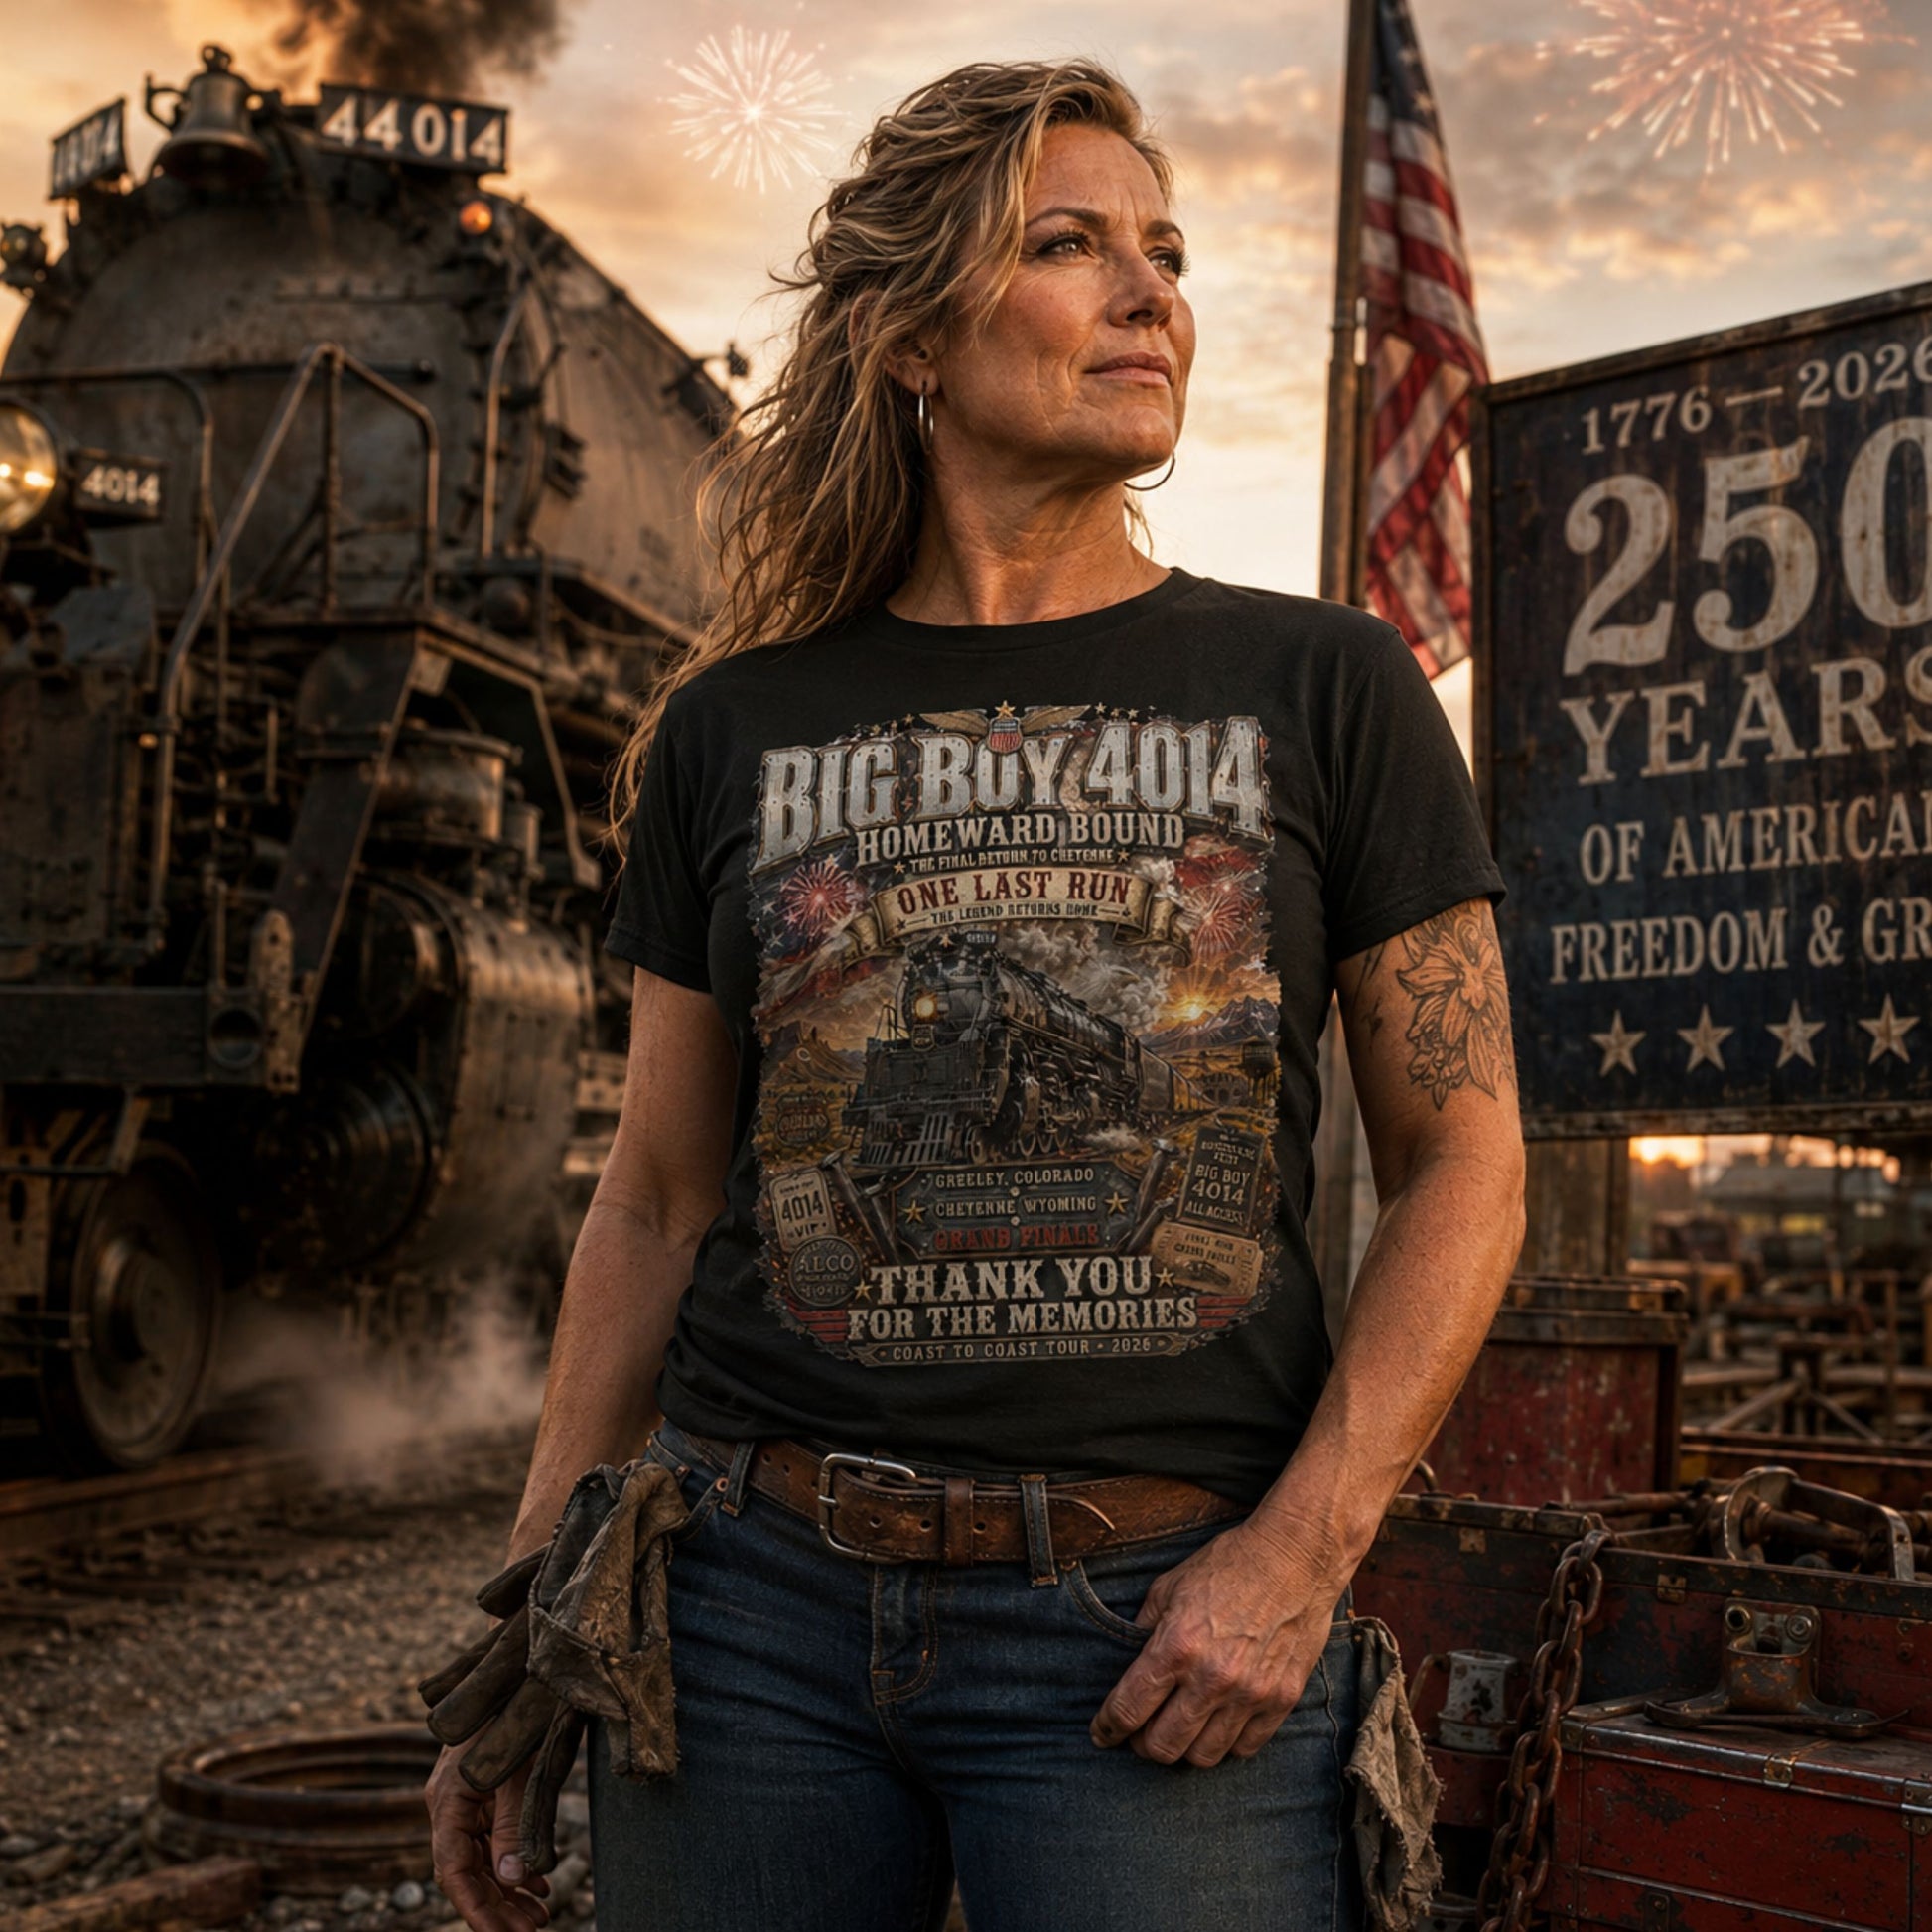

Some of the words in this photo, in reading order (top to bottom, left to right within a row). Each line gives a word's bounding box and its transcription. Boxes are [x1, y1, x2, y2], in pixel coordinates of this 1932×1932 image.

[322, 94, 503, 166] 44014
[1581, 385, 1713, 454] 1776
[1798, 335, 1932, 410] 2026
[81, 465, 160, 506] 4014
[1562, 416, 1932, 677] 250
[752, 741, 901, 872] BIG
[907, 732, 1074, 823] BOY
[1084, 715, 1273, 844] 4014
[855, 812, 1057, 866] HOMEWARD
[1070, 812, 1184, 849] BOUND
[1580, 820, 1644, 885] OF
[897, 877, 959, 914] ONE
[973, 870, 1052, 901] LAST
[1066, 871, 1133, 904] RUN
[1550, 907, 1789, 984] FREEDOM
[1807, 903, 1844, 968] &
[1014, 1167, 1094, 1184] COLORADO
[1191, 1178, 1244, 1206] 4014
[1195, 1164, 1219, 1180] BIG
[1222, 1168, 1251, 1186] BOY
[782, 1191, 824, 1223] 4014
[1023, 1196, 1096, 1213] WYOMING
[794, 1254, 854, 1274] ALCO
[870, 1258, 1045, 1306] THANK
[1055, 1255, 1153, 1298] YOU
[847, 1307, 916, 1340] FOR
[926, 1304, 996, 1337] THE
[1007, 1296, 1197, 1335] MEMORIES
[893, 1345, 945, 1361] COAST
[953, 1344, 974, 1358] TO
[984, 1342, 1038, 1358] COAST
[1046, 1340, 1090, 1356] TOUR
[1111, 1338, 1152, 1353] 2026
